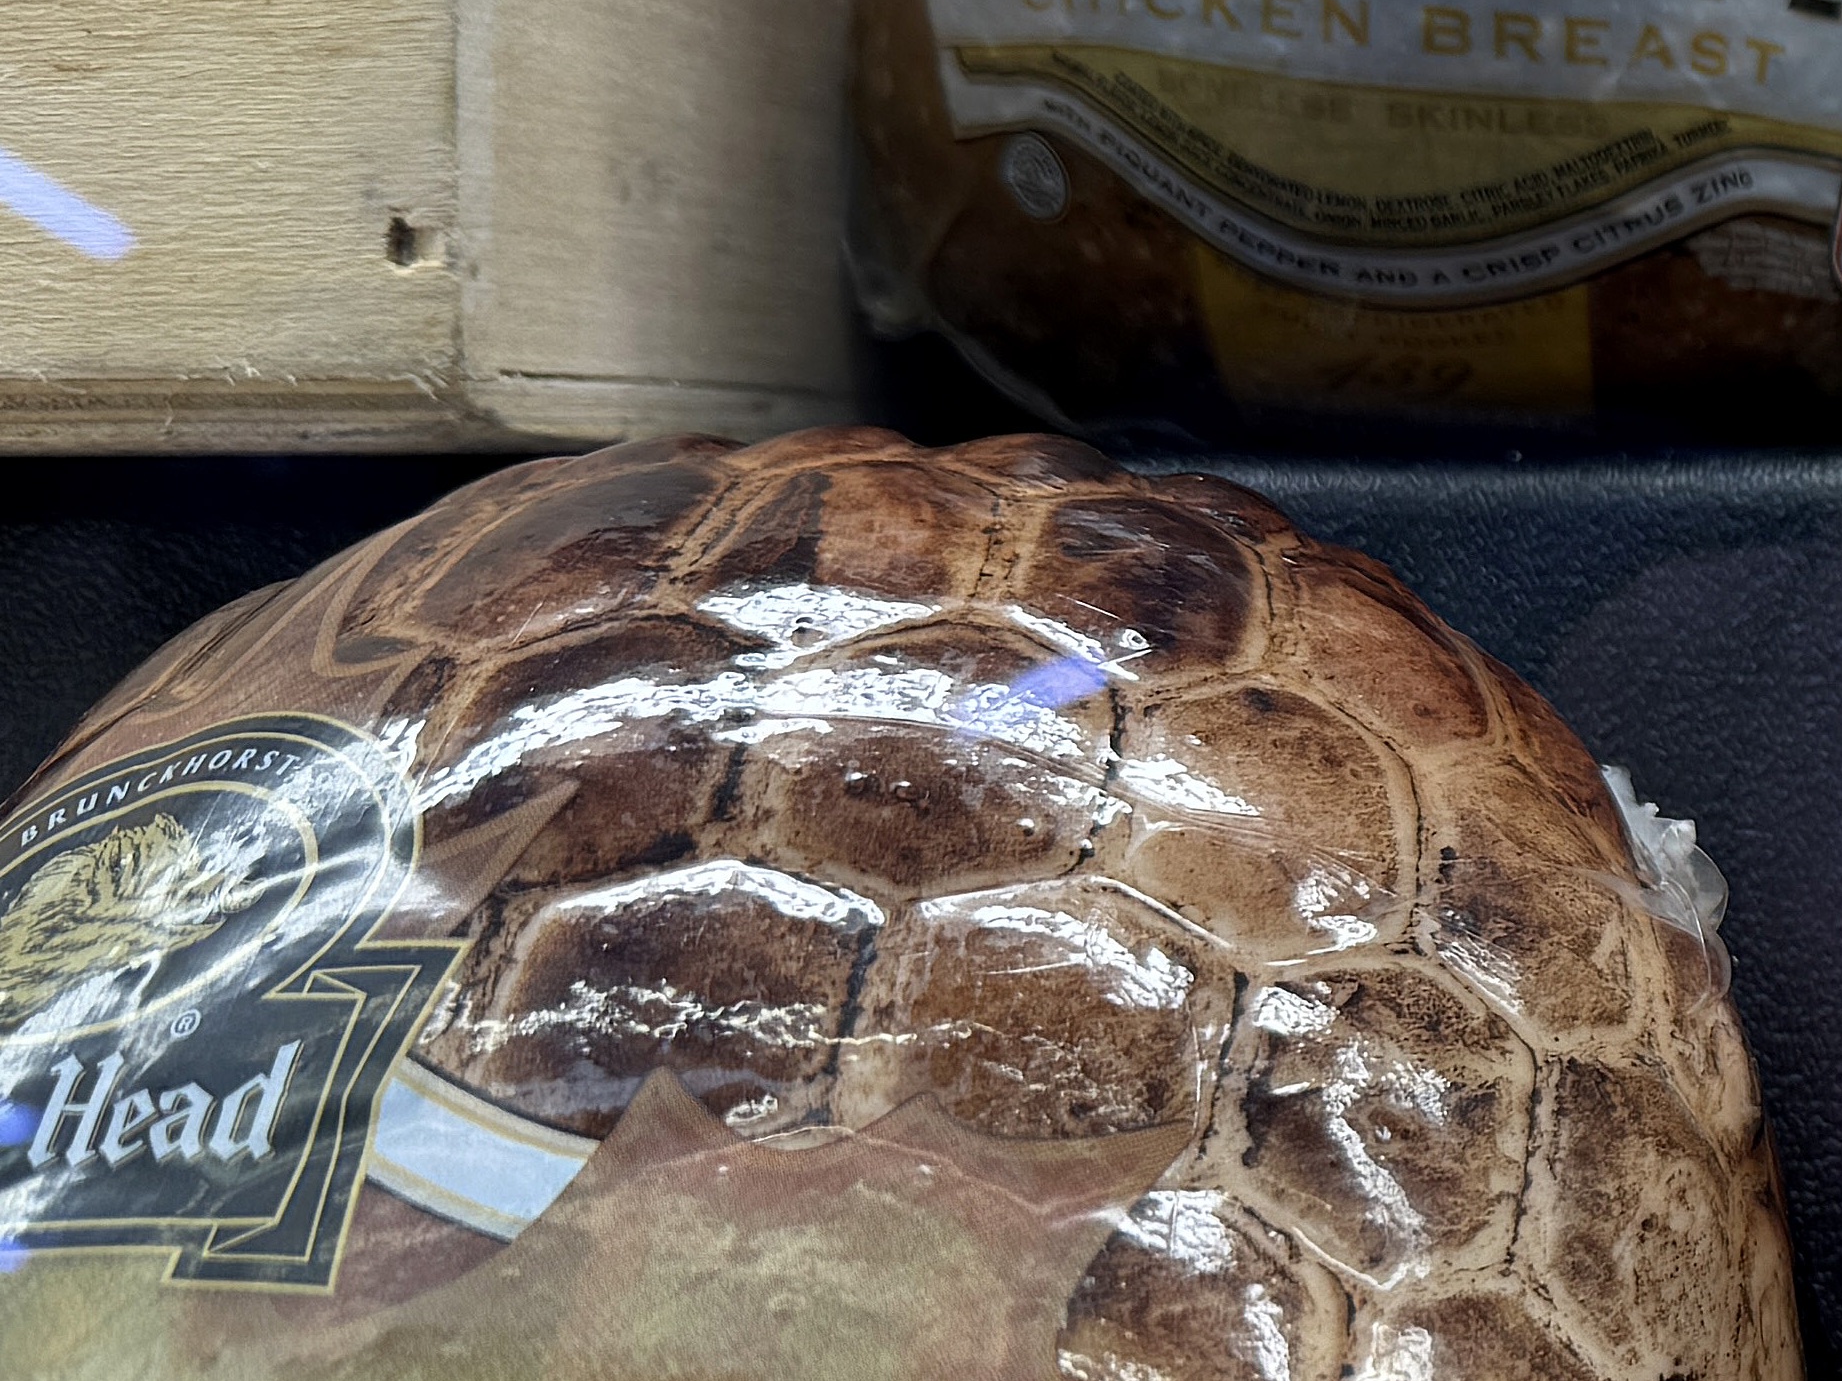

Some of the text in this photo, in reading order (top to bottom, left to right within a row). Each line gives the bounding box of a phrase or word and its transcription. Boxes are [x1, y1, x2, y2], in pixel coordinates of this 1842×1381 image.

[1422, 6, 1788, 87] BREAST
[1220, 220, 1341, 277] PEPPER
[1356, 269, 1419, 289] AND
[1433, 271, 1450, 285] A
[1463, 246, 1560, 283] CRISP
[1572, 196, 1685, 255] CITRUS
[25, 1040, 303, 1169] Head
